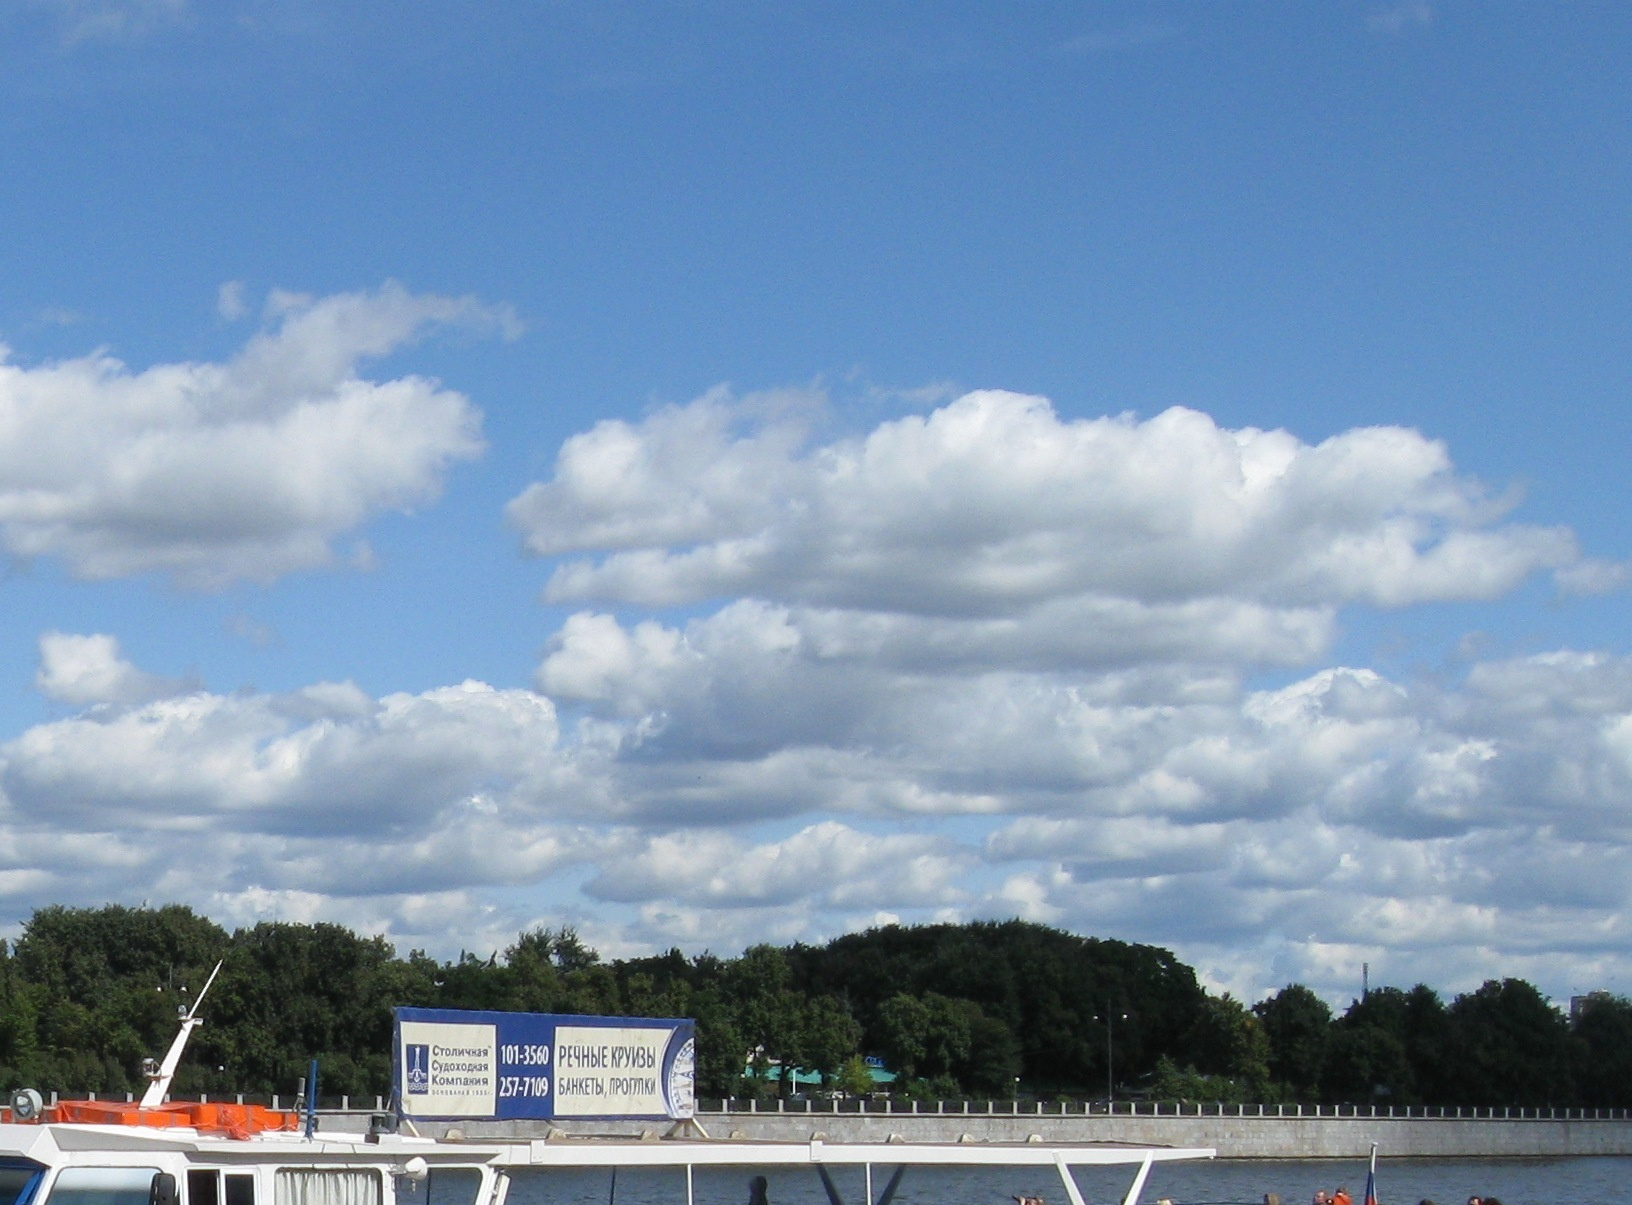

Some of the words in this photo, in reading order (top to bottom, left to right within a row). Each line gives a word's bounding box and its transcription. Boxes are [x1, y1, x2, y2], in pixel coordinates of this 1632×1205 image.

[432, 1045, 488, 1057] Столичная
[500, 1044, 549, 1065] 101-3560
[559, 1045, 608, 1068] РЕЧНЫЕ
[611, 1046, 656, 1069] КРУИЗЫ
[432, 1059, 488, 1074] Судоходная
[432, 1074, 488, 1086] Компания
[499, 1076, 549, 1097] 257-7109
[558, 1077, 607, 1098] БАНКЕТЫ,
[609, 1077, 656, 1096] ПРОГУЛКИ
